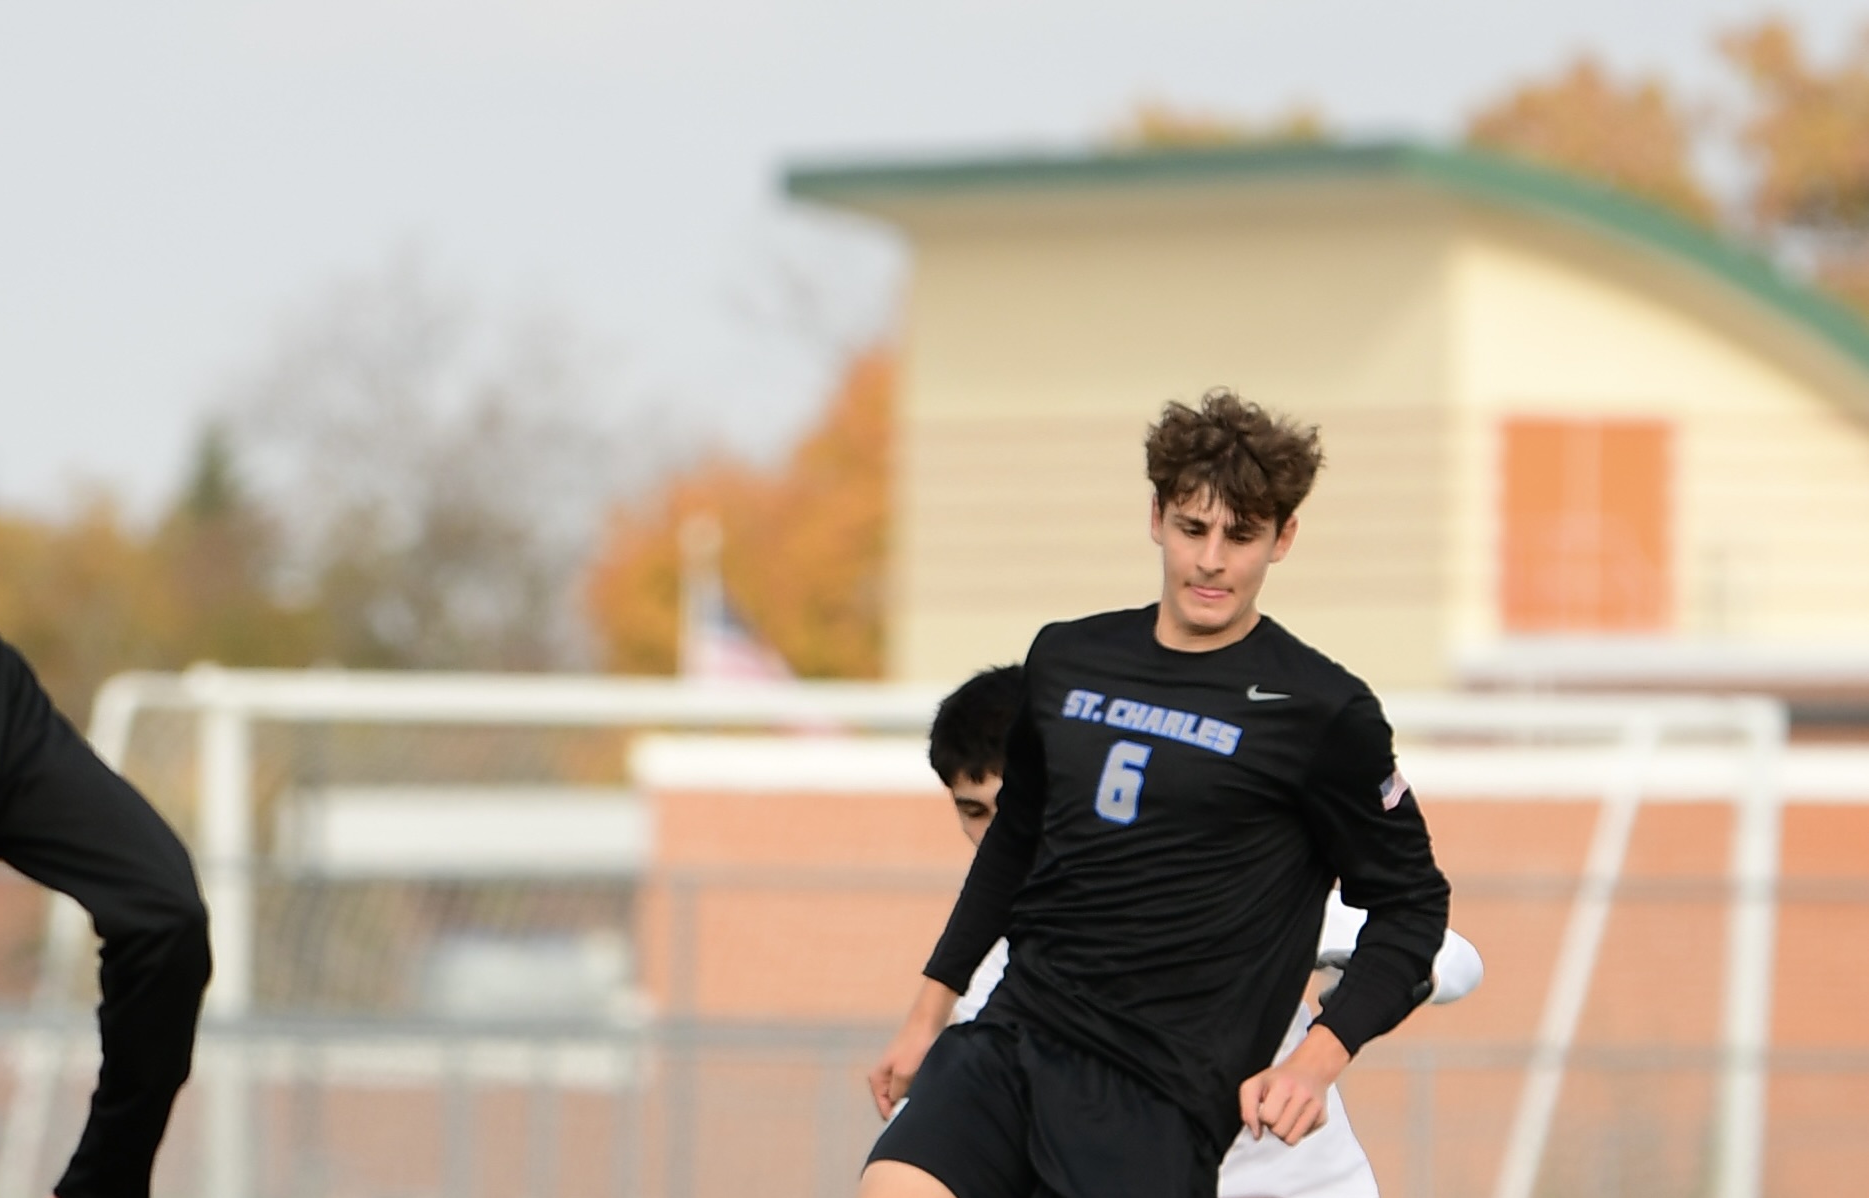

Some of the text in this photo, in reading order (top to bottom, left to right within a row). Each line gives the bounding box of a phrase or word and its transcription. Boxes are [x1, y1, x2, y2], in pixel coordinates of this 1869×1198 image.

[1062, 689, 1243, 756] ST. CHARLES
[1094, 738, 1153, 826] 6
